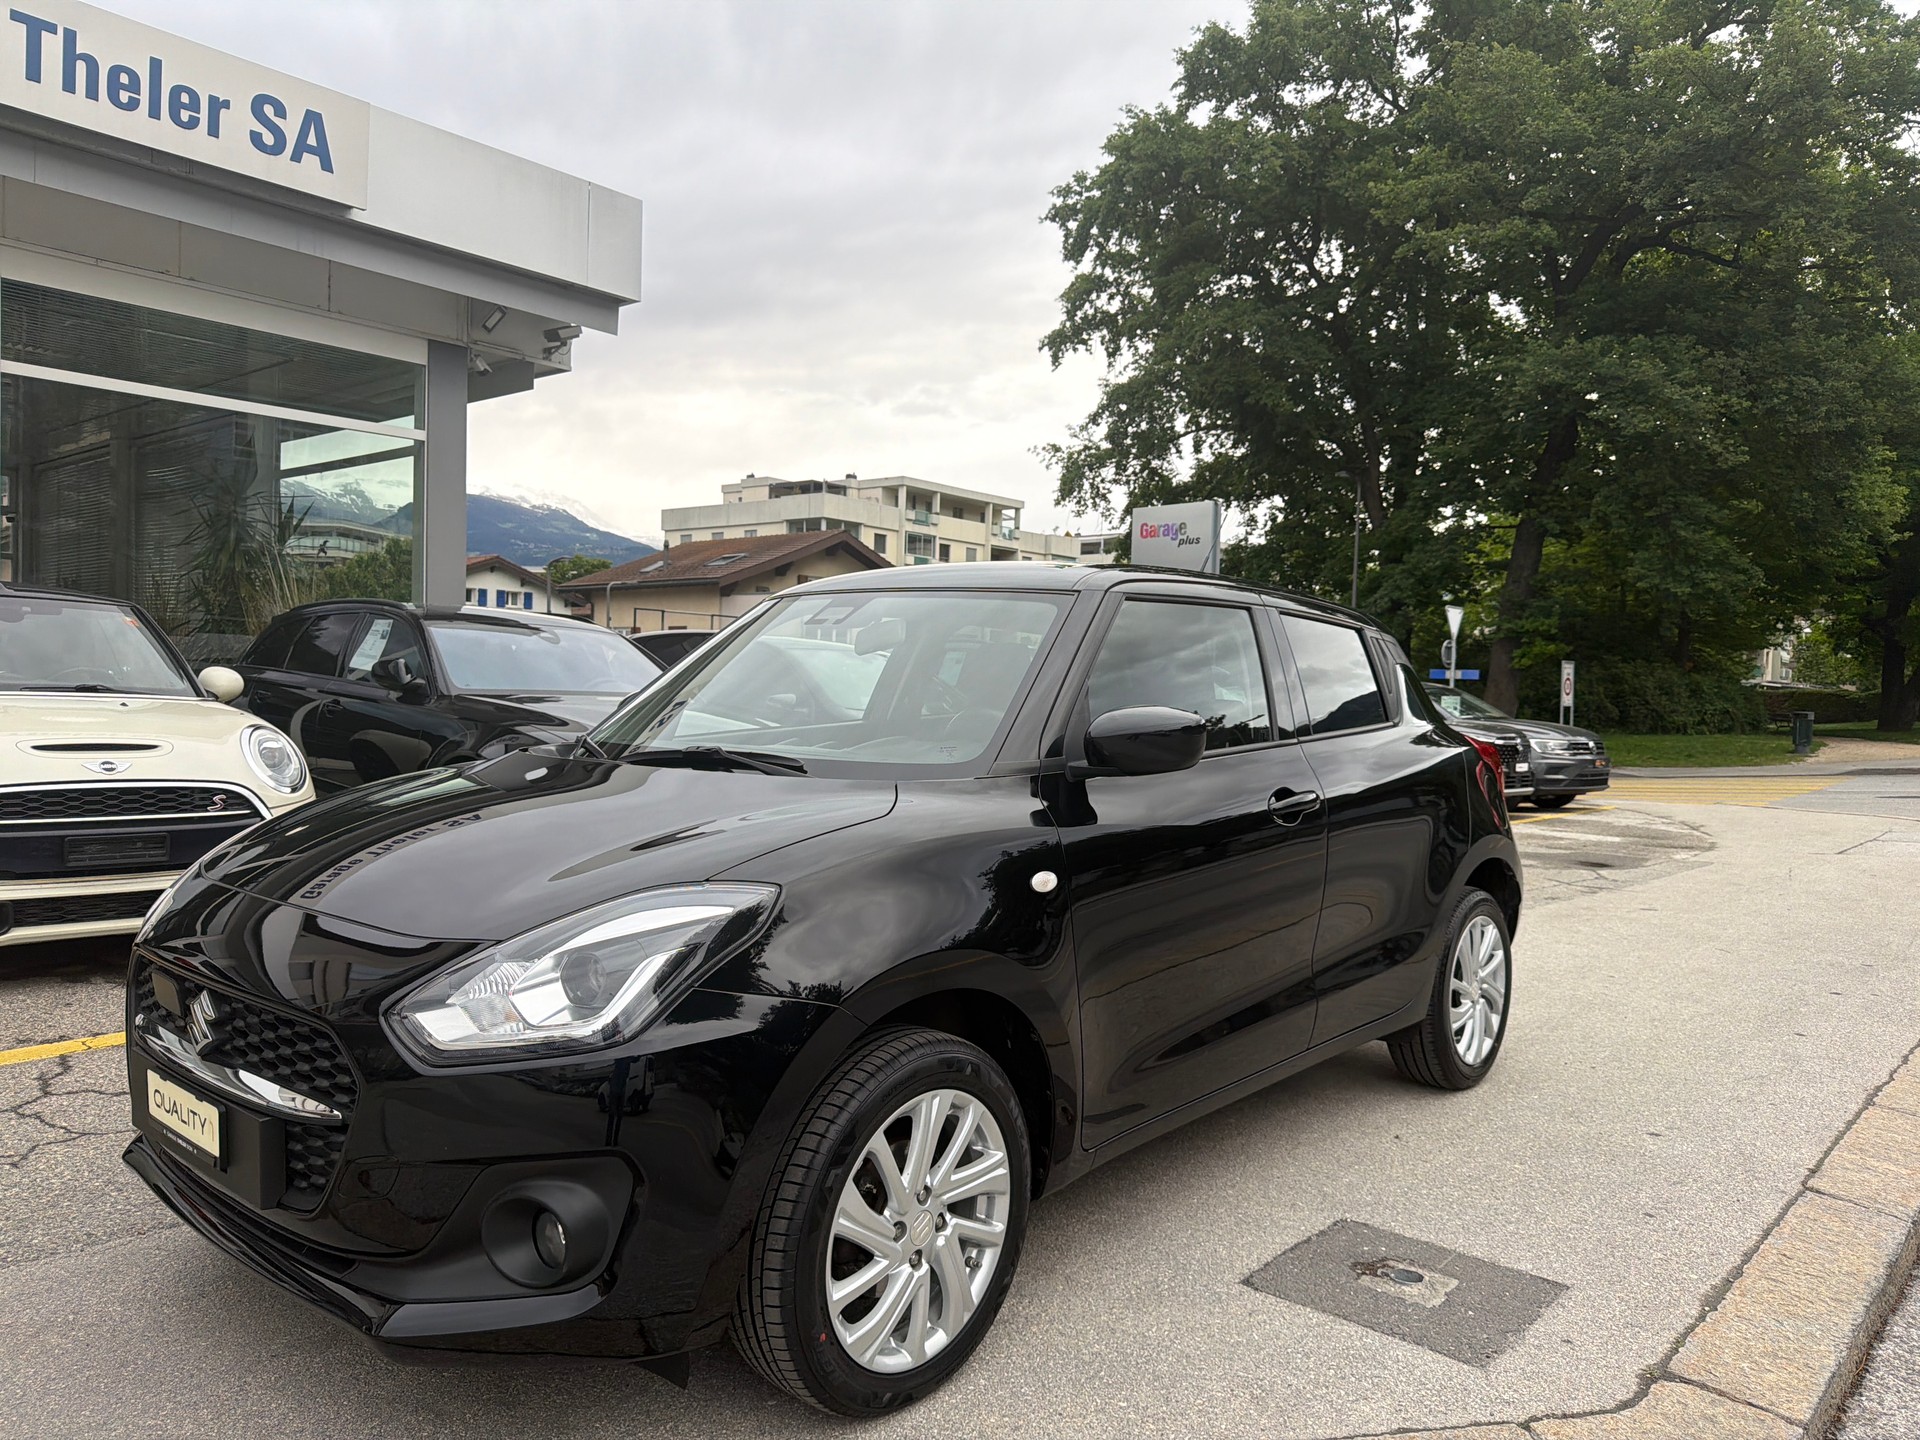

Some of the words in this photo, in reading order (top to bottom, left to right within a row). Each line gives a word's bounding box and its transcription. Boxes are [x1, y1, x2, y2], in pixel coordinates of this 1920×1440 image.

[9, 8, 231, 139] Theler
[248, 92, 335, 175] SA
[1140, 522, 1187, 541] Garage
[1177, 535, 1201, 548] plus
[206, 794, 227, 812] S
